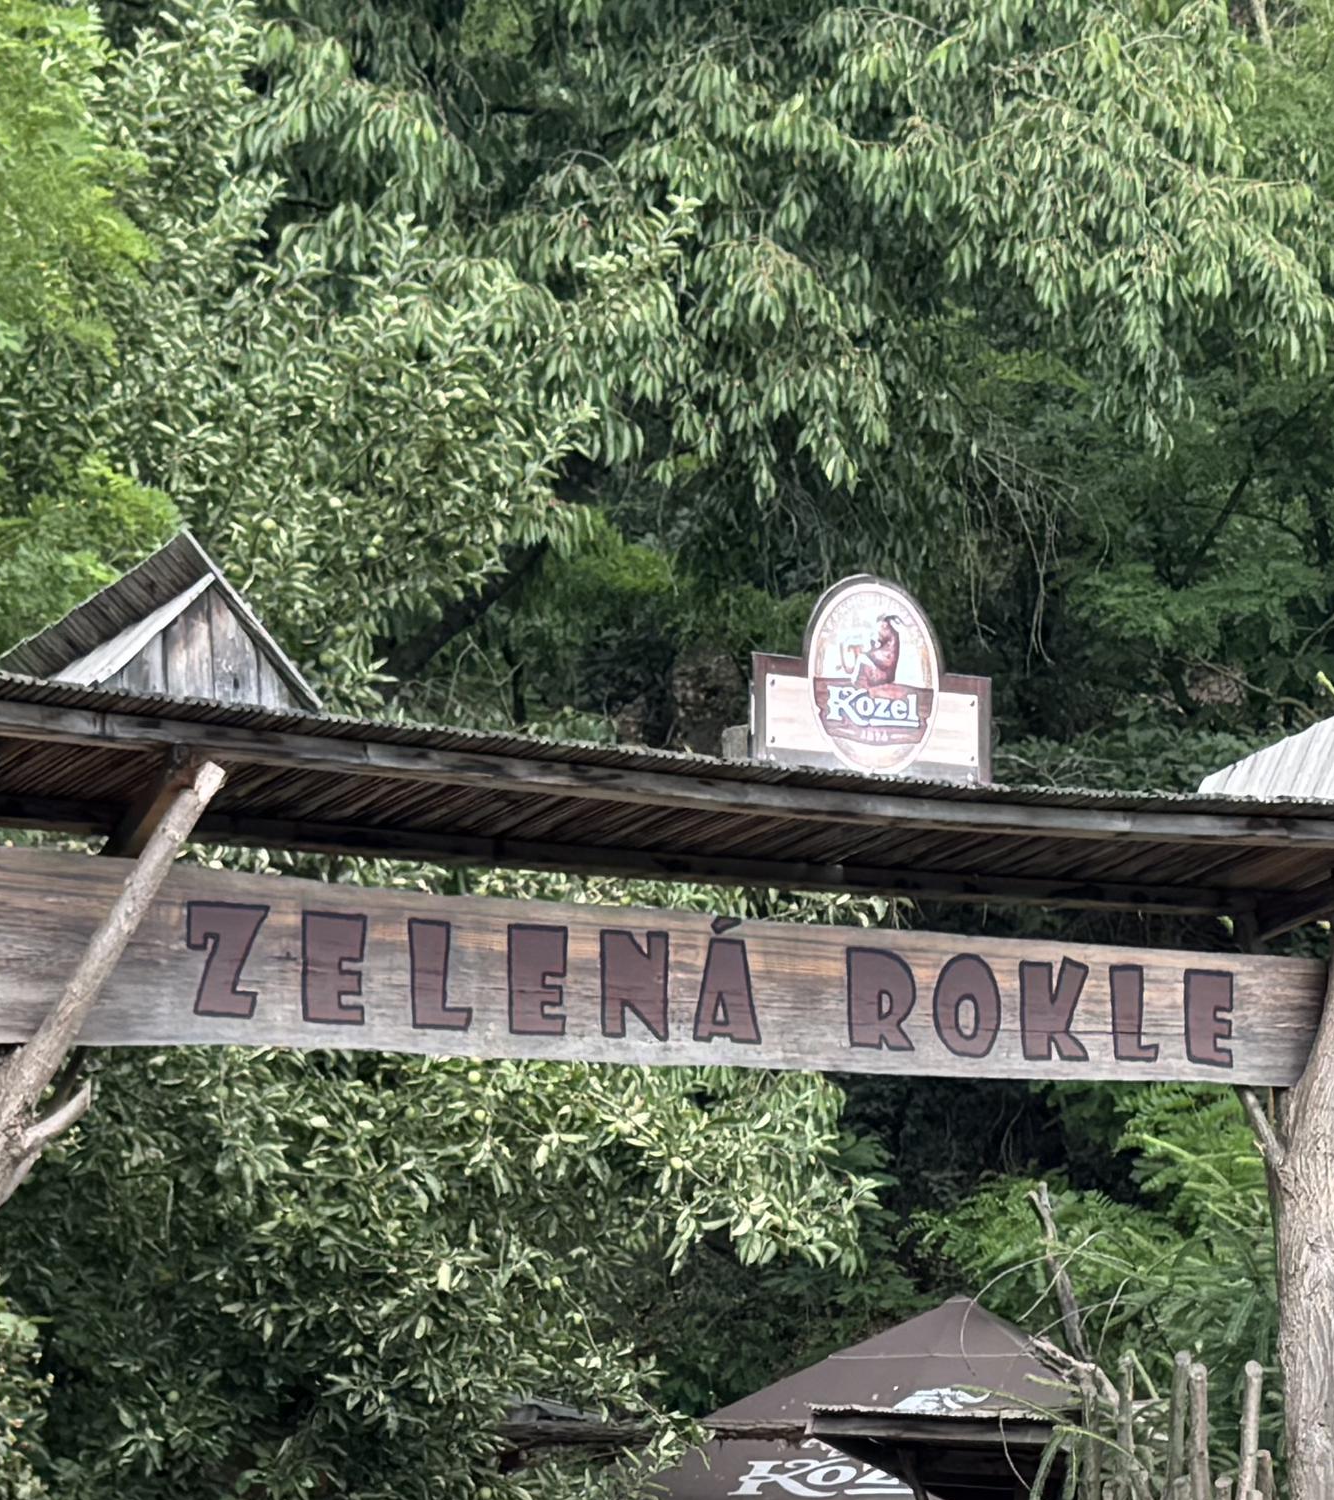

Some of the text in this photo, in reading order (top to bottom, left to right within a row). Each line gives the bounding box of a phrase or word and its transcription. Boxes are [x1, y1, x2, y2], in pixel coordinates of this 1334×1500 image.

[826, 684, 920, 727] Kozel
[186, 900, 1234, 1068] ZELENÁ ROKLE
[727, 1456, 900, 1497] Koz
